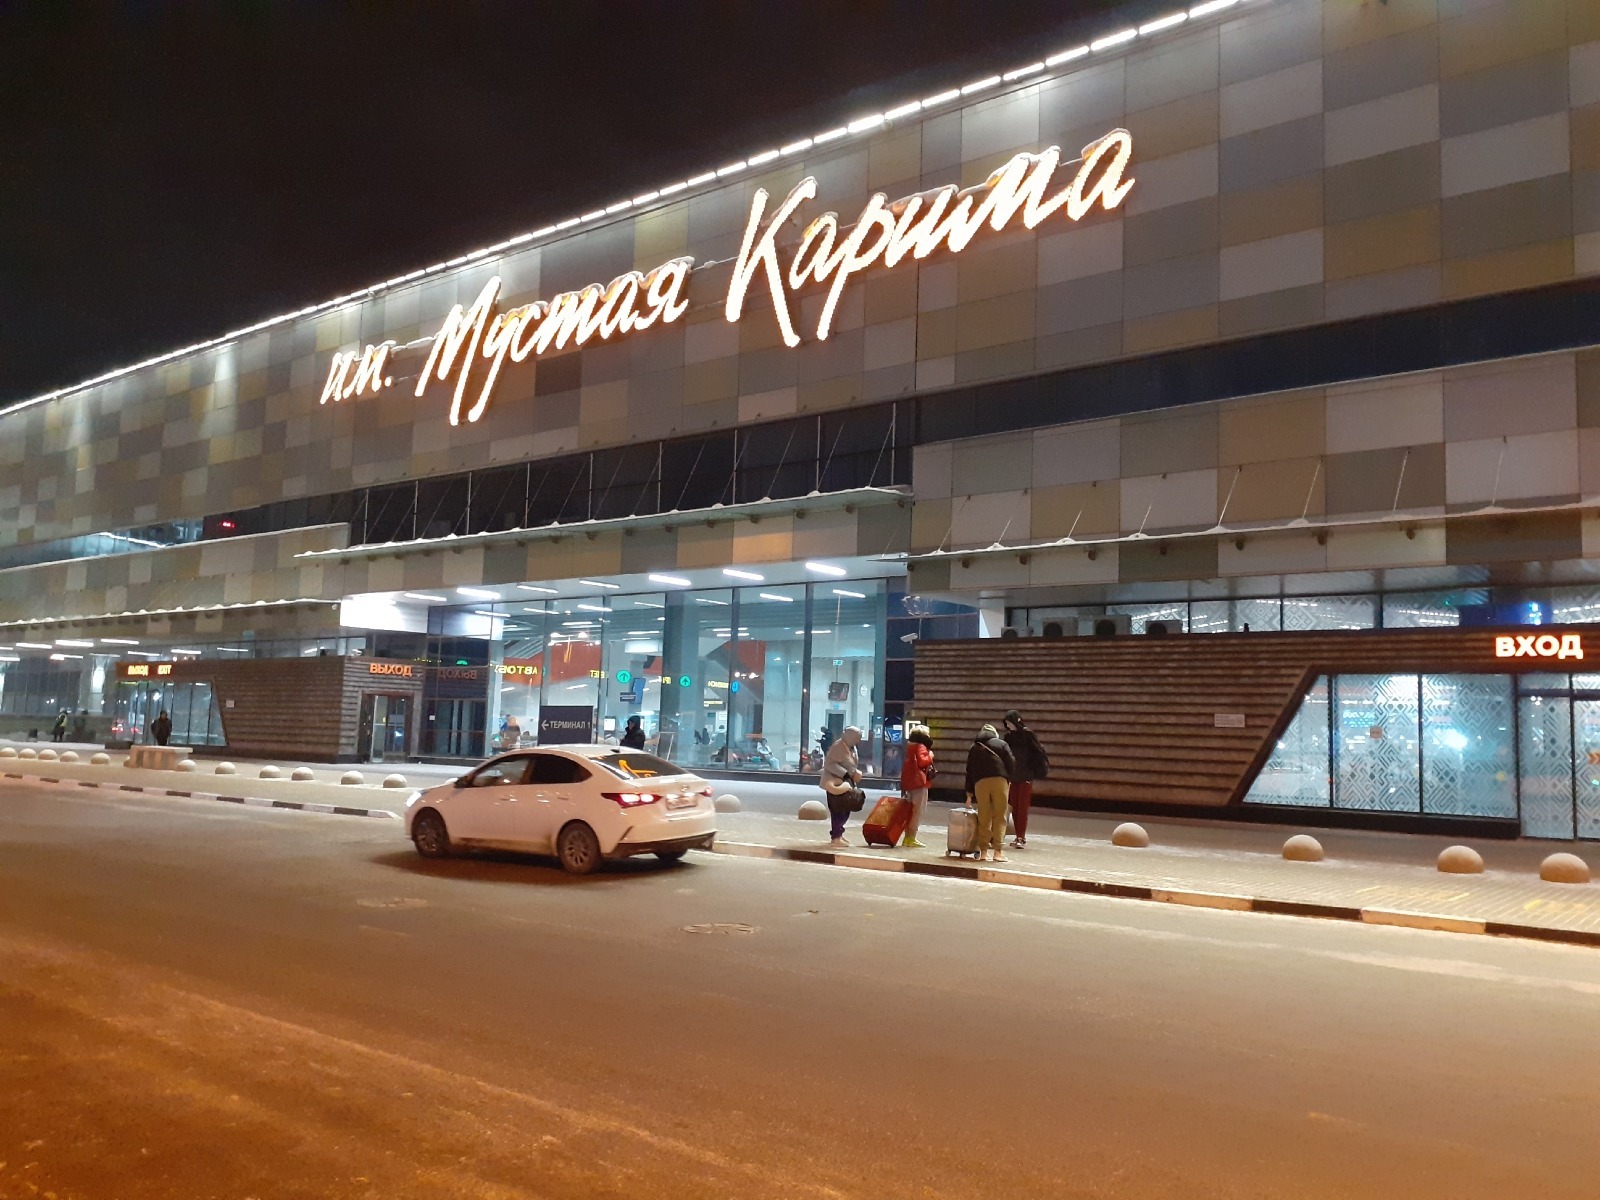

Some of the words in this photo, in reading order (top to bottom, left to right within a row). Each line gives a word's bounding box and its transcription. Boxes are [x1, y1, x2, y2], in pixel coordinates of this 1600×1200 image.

[320, 343, 392, 405] им.
[414, 259, 692, 426] Мустая
[725, 128, 1136, 348] Карима
[1495, 634, 1584, 660] ВХОД
[369, 662, 413, 678] ВЫХОД
[549, 720, 586, 730] ТЕРМИНАЛ
